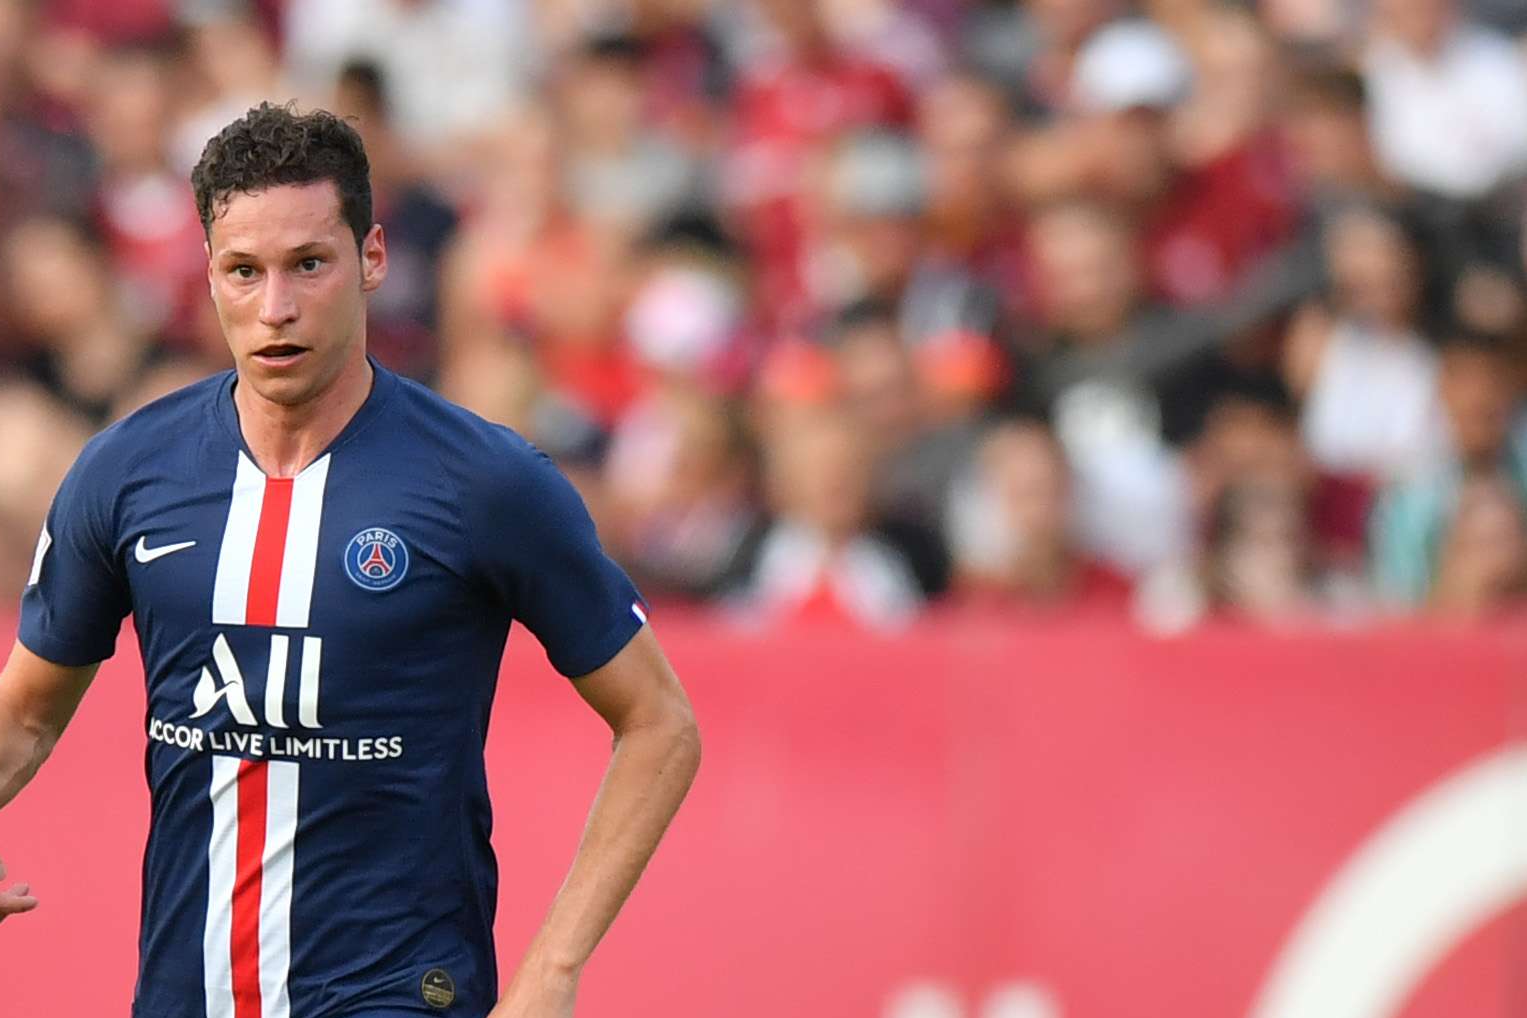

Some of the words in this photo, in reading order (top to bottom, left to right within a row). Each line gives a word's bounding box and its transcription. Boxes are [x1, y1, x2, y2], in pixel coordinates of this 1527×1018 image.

[356, 531, 398, 549] PARIS
[209, 731, 264, 756] LIVE
[270, 736, 403, 761] LIMITLESS
